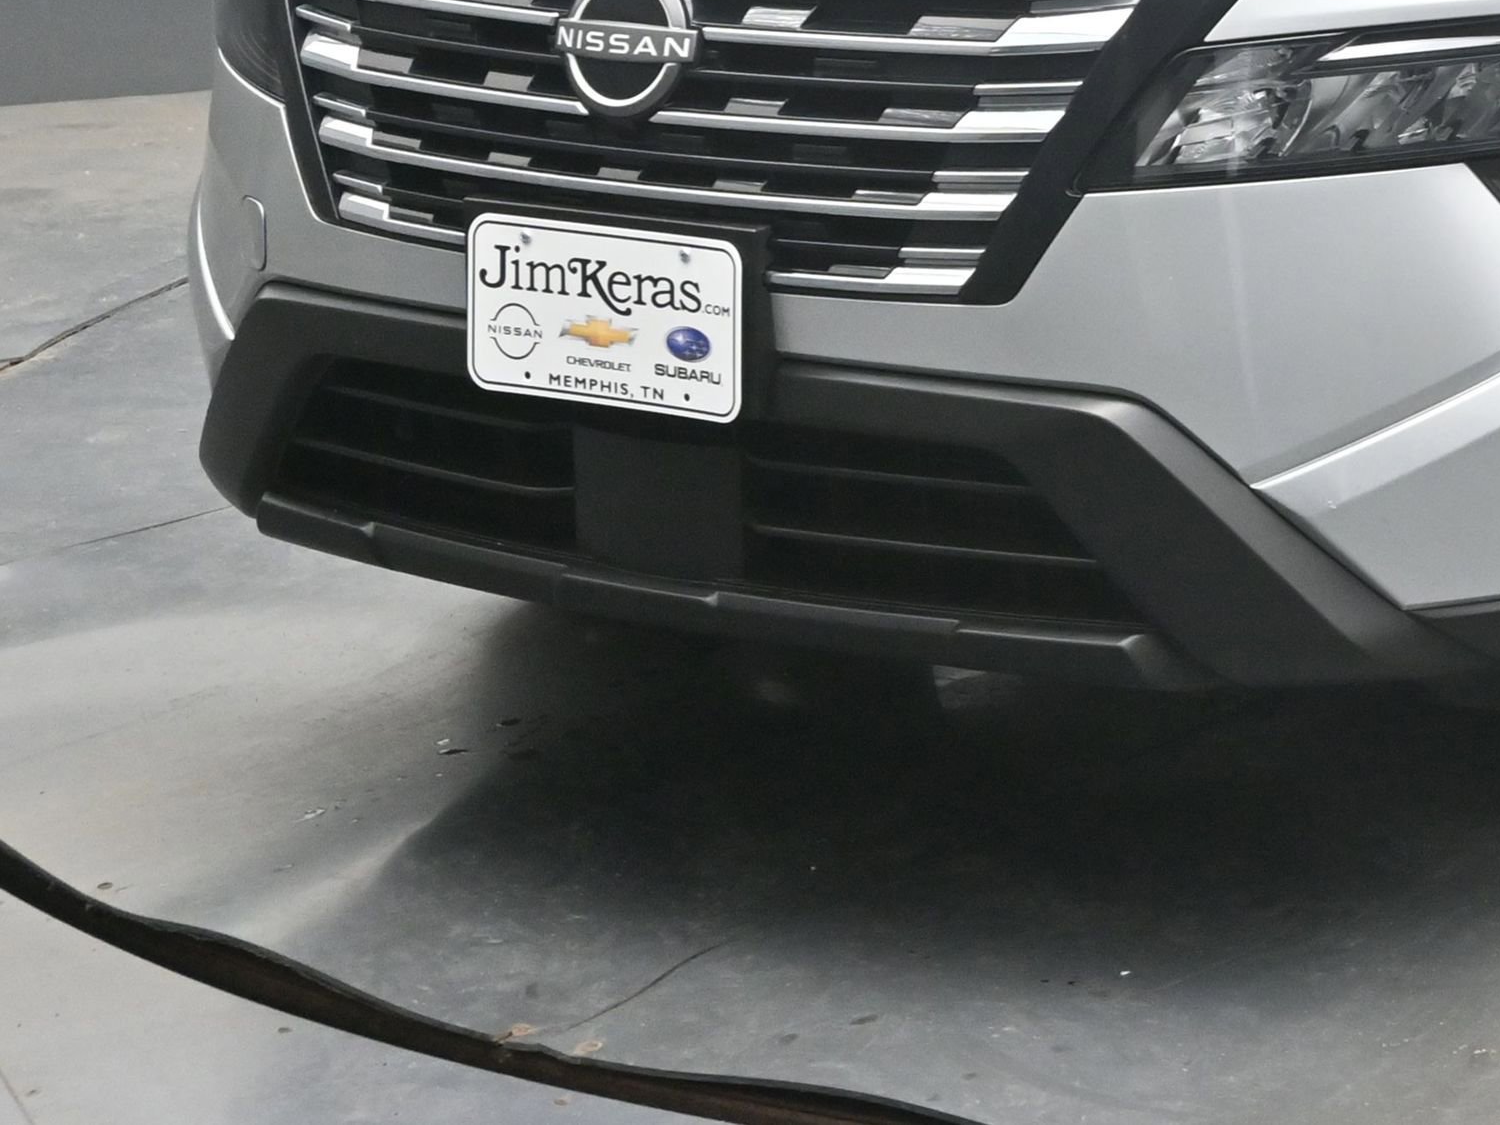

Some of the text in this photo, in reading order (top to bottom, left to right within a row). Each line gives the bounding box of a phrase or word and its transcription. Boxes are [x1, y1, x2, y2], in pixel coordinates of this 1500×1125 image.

[557, 26, 691, 57] NISSAN
[487, 324, 543, 339] NISSAN
[566, 355, 631, 373] CHEVROLET
[654, 363, 722, 385] SUBARU
[549, 373, 664, 401] MEMPHIS, TN
